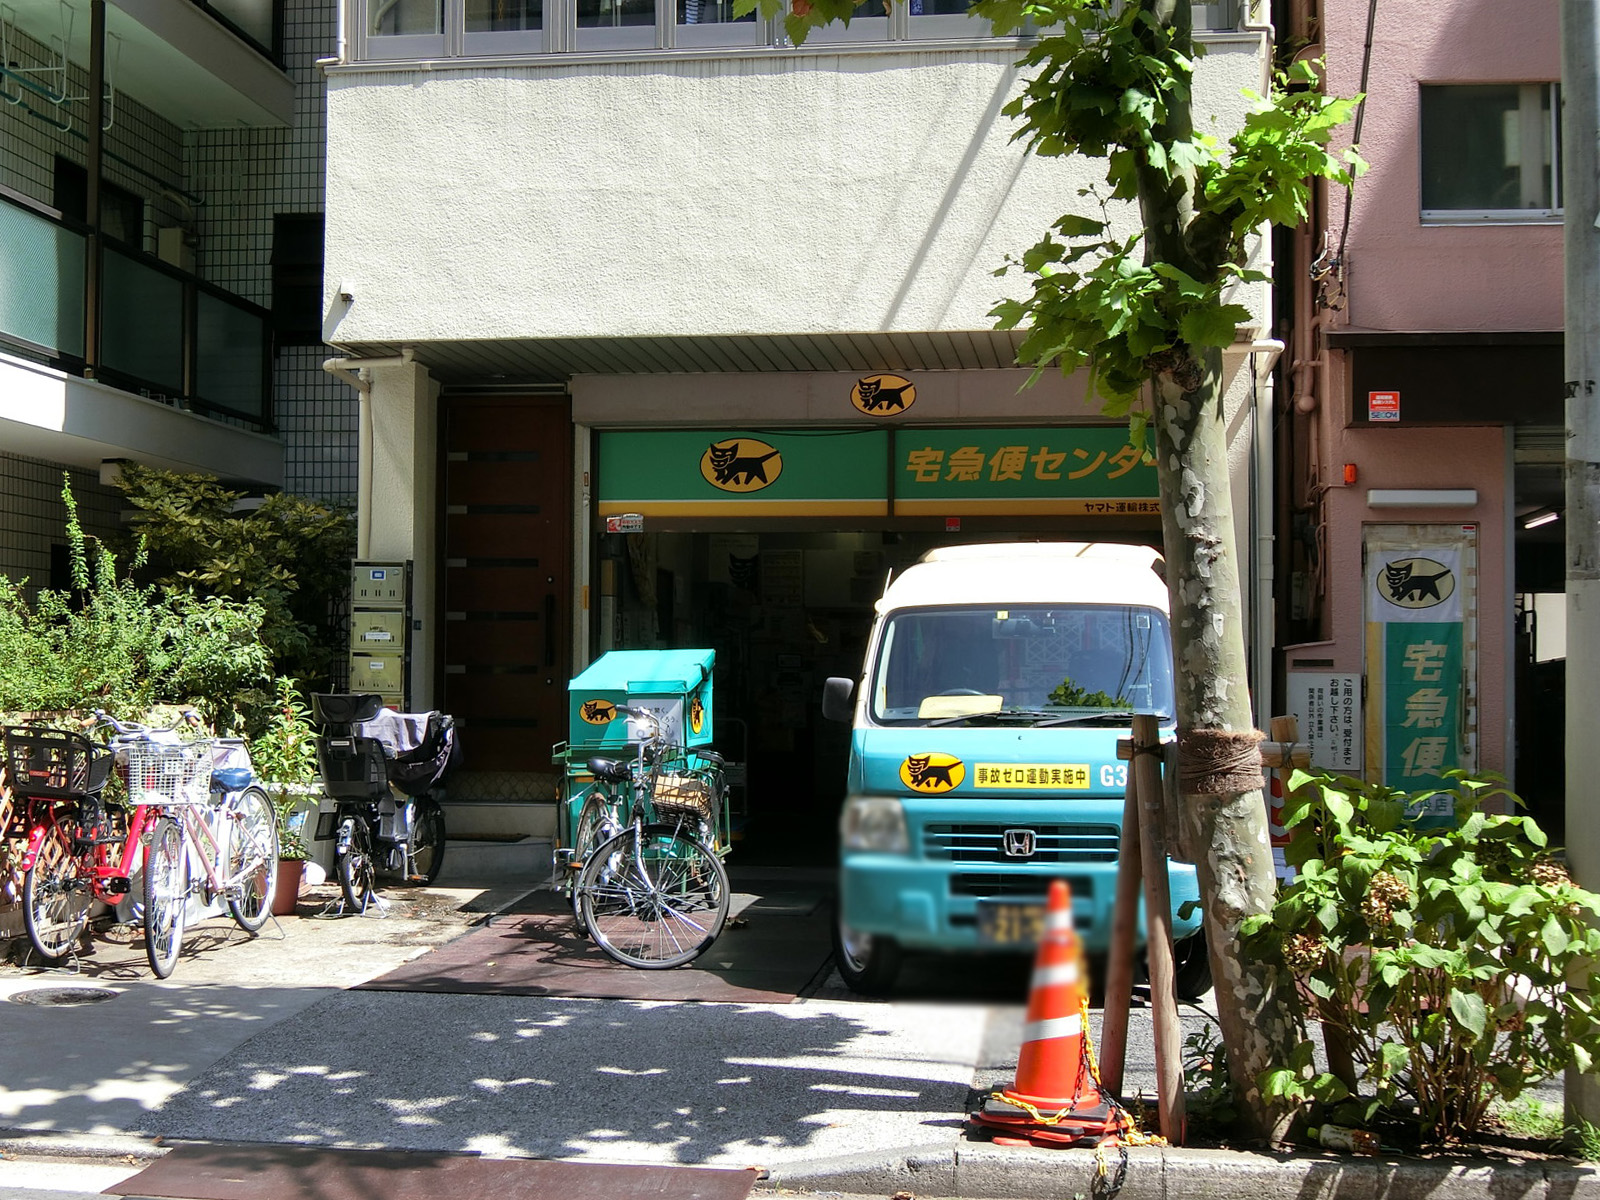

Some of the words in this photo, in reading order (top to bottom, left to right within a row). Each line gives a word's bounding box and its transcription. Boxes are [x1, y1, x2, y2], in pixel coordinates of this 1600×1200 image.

[1343, 679, 1353, 765] ご用の方は、受付まで
[1400, 640, 1448, 777] 宅急便
[978, 767, 1086, 785] 事故ゼロ運動実施中
